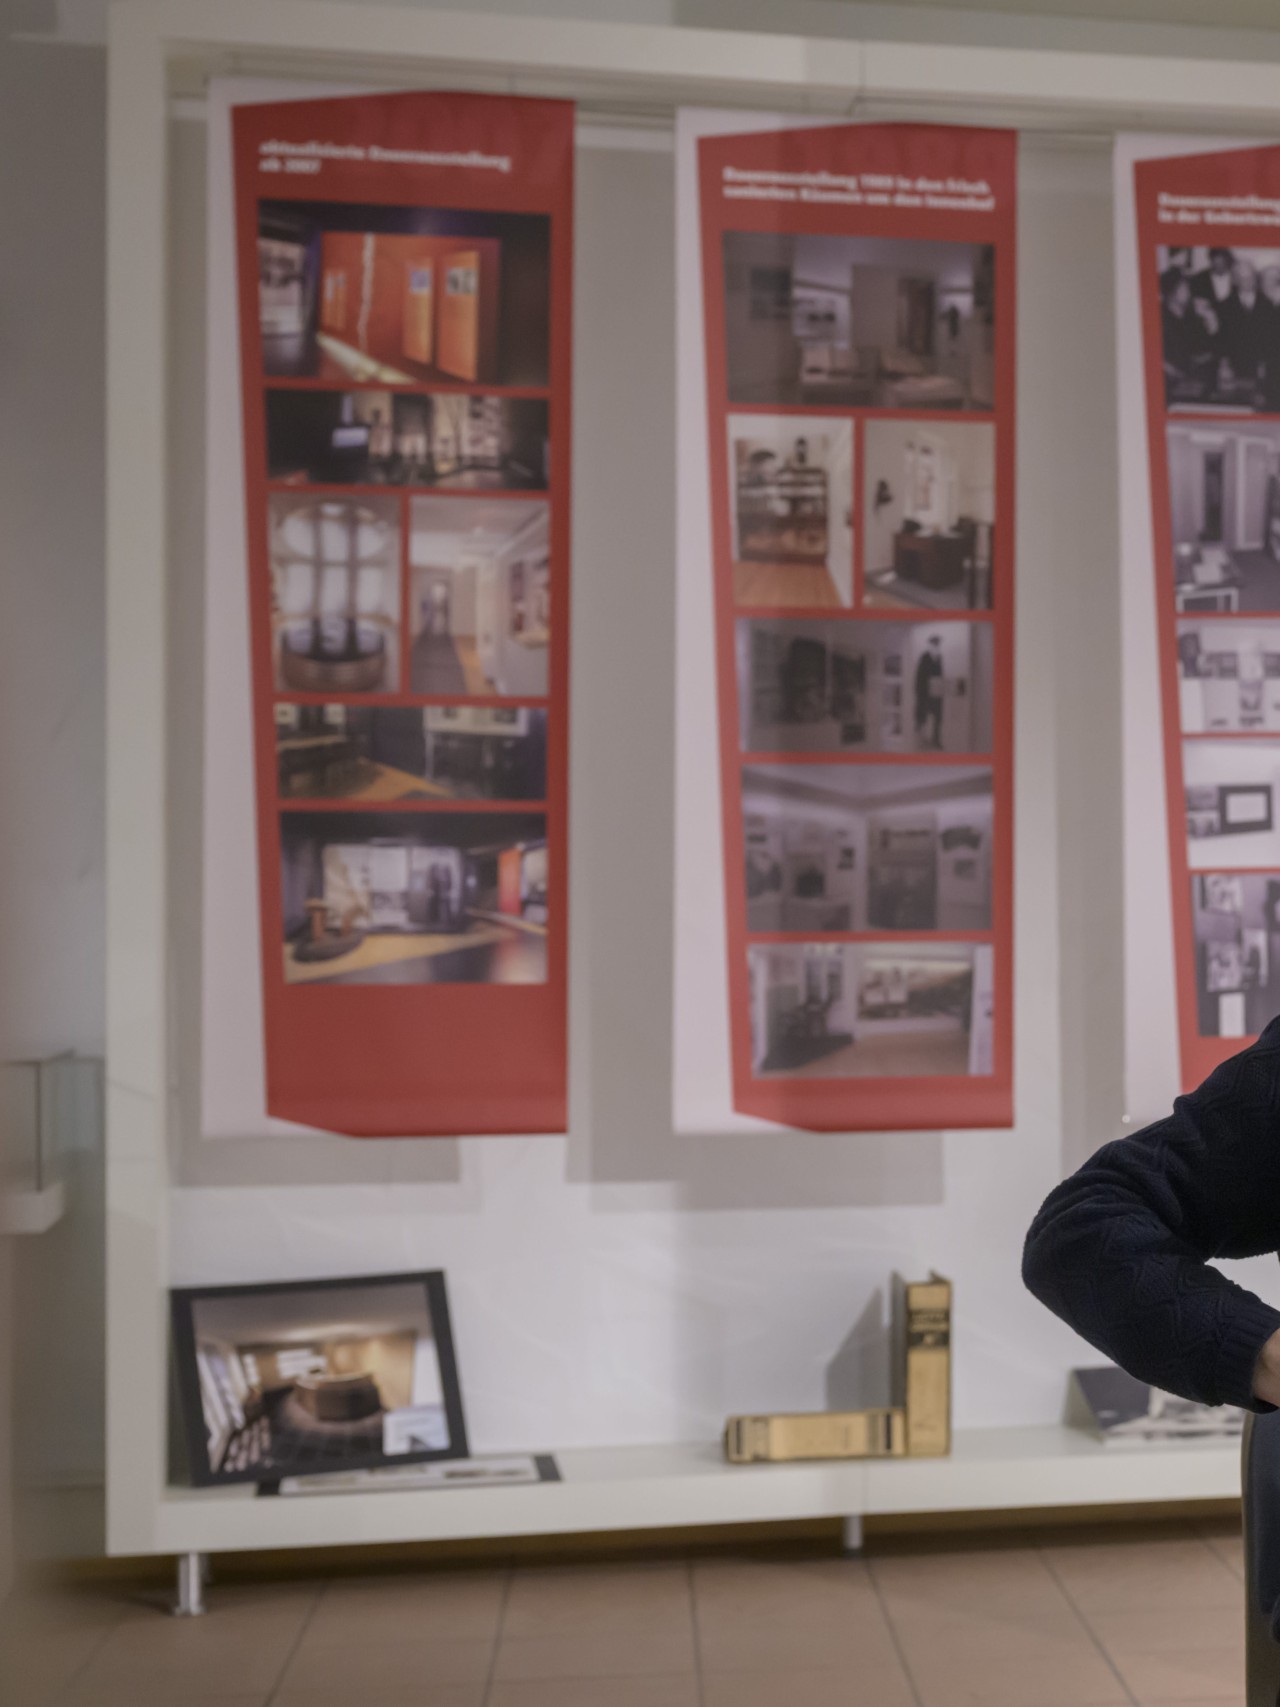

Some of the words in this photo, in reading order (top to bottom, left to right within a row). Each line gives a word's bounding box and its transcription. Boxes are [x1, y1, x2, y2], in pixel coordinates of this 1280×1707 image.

[368, 144, 512, 173] Dauerausstellung
[722, 166, 859, 190] Dauerausstellung
[914, 176, 944, 192] den
[1157, 208, 1174, 223] in
[1176, 209, 1201, 224] der
